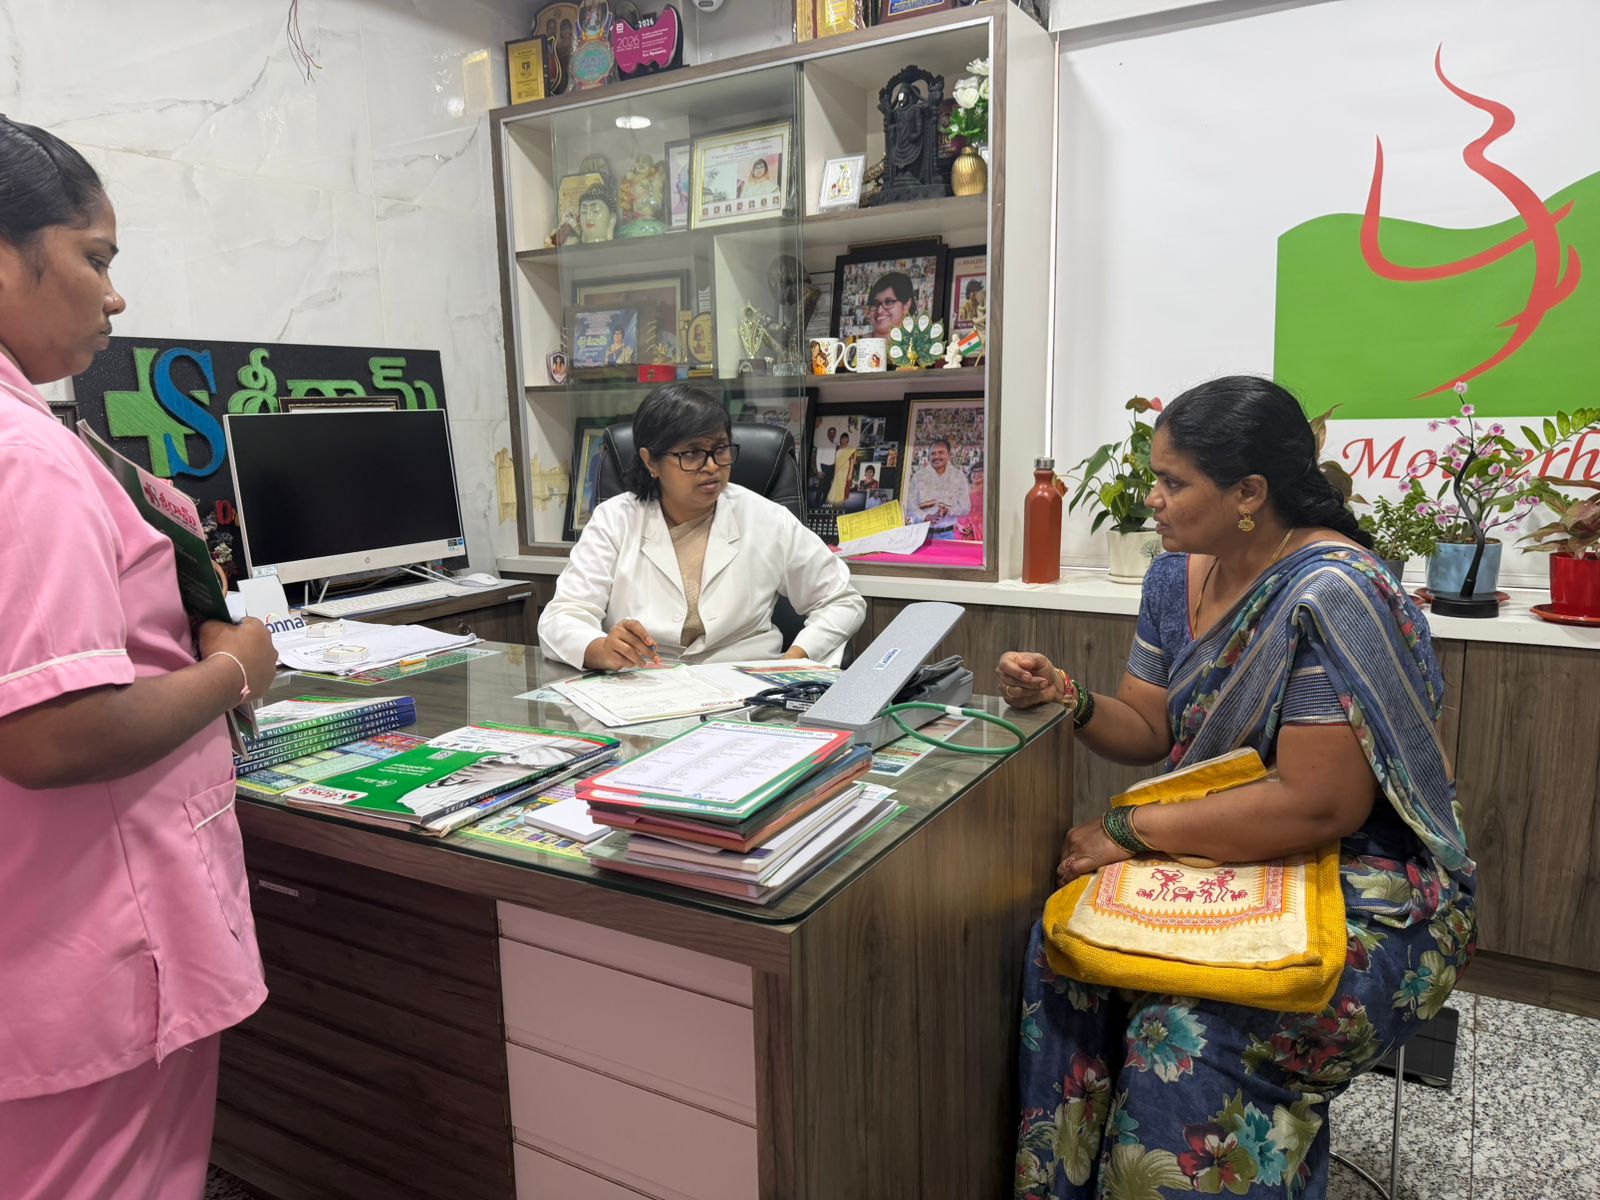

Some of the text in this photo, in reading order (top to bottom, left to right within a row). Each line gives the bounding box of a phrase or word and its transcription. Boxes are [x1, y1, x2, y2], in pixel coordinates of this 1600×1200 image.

[1342, 429, 1600, 481] Moerh
[266, 726, 291, 736] MULTI
[292, 719, 318, 729] SUPER
[319, 709, 361, 722] SPECIALITY
[364, 700, 398, 712] HOSPITAL
[267, 736, 291, 746] MULTI
[293, 728, 318, 739] SUPER
[320, 717, 362, 732] SPECIALITY
[364, 708, 398, 720] HOSPITAL
[268, 745, 291, 755] MULTI
[294, 737, 318, 748] SUPER
[366, 715, 399, 728] HOSPITAL
[240, 761, 270, 774] SRIRAM
[272, 753, 295, 764] MULTI
[298, 745, 321, 755] SUPER
[324, 732, 365, 748] SPECIALITY
[367, 722, 400, 735] HOSPITAL
